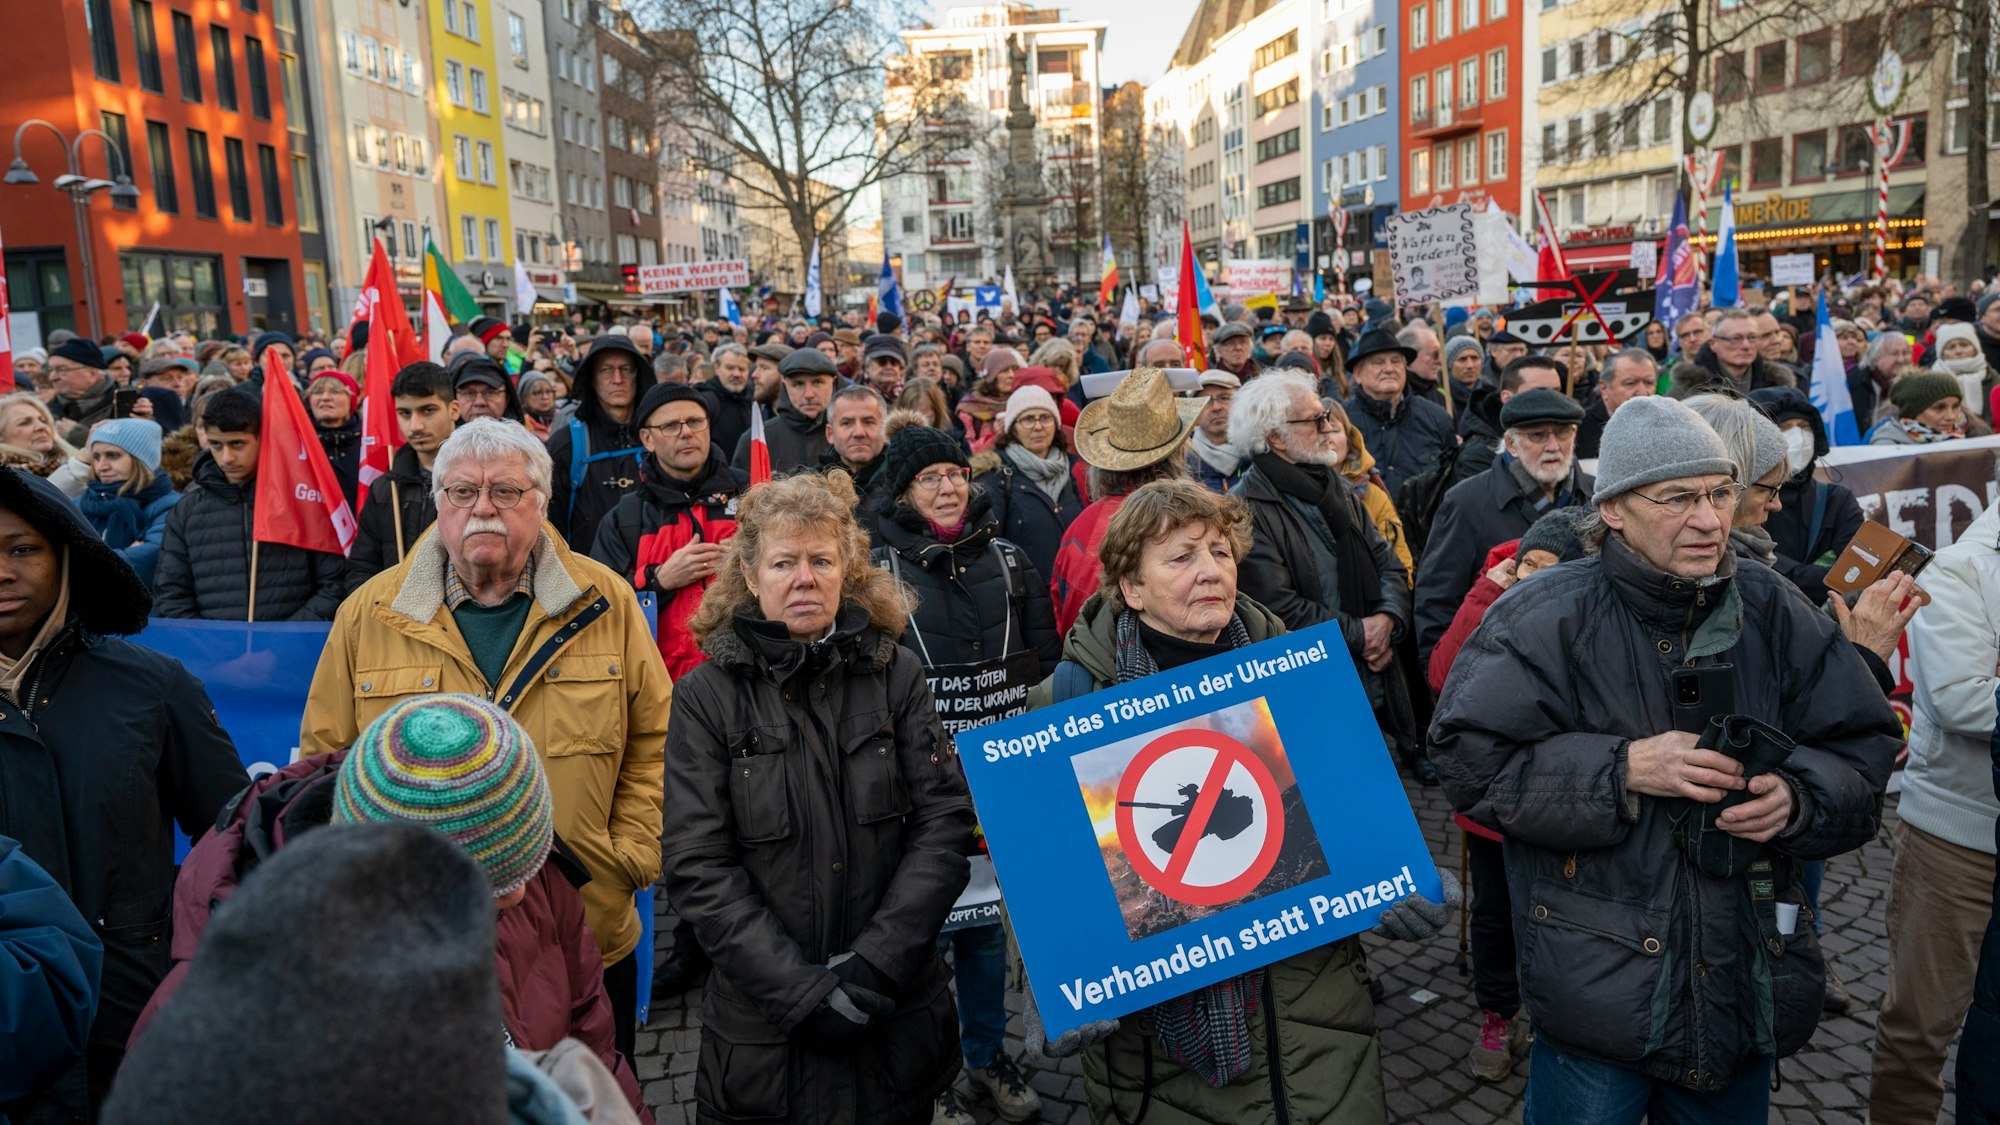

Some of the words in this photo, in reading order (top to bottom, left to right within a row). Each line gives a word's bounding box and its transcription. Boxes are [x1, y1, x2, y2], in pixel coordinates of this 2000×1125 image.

[1733, 192, 1810, 226] IMERIDE
[1401, 233, 1455, 249] Waffen
[643, 266, 684, 278] KEINE
[689, 262, 744, 274] WAFFEN
[645, 279, 679, 291] KEIN
[684, 275, 728, 288] KRIEG
[733, 274, 745, 284] !!!
[1856, 481, 1998, 551] ED
[926, 677, 939, 693] T
[942, 676, 971, 693] DAS
[973, 668, 1007, 691] TÖTEN
[935, 699, 950, 713] IN
[954, 697, 983, 712] DER
[983, 684, 1027, 709] UKRAINE
[983, 723, 1061, 763] Stoppt
[1063, 713, 1104, 738] das
[1104, 693, 1170, 724] Töten
[1171, 683, 1196, 704] in
[1198, 673, 1234, 696] der
[1236, 640, 1328, 683] Ukraine!
[1059, 934, 1235, 1011] Verhandeln
[1238, 905, 1310, 951] statt
[1308, 865, 1417, 925] Panzer!
